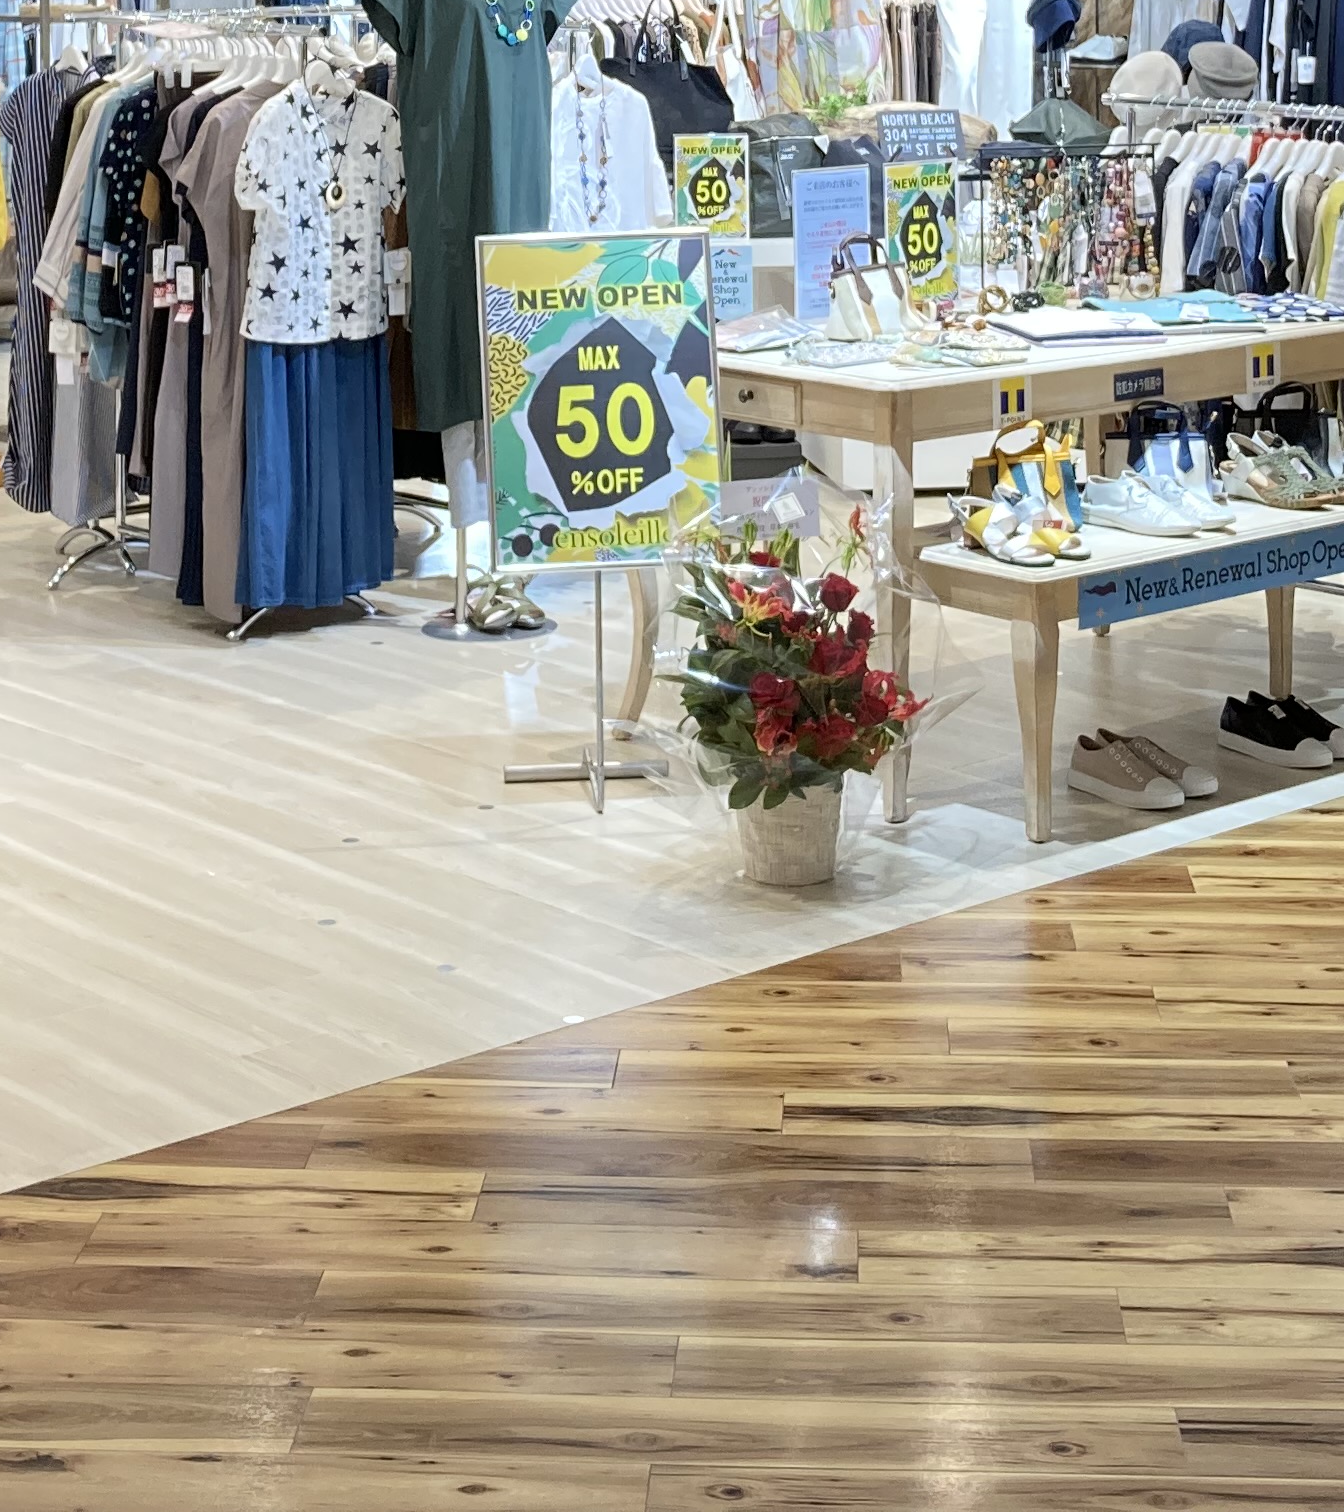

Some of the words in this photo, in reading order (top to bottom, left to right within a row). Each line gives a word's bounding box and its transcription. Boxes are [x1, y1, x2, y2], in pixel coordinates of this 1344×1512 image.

[881, 112, 917, 127] NORTH
[920, 112, 955, 126] BEACH
[883, 128, 908, 142] 304
[682, 146, 707, 155] NEW
[710, 146, 742, 155] OPEN
[702, 166, 718, 178] MAX
[892, 178, 918, 190] NEW
[920, 174, 951, 187] OPEN
[696, 180, 727, 204] 50
[912, 205, 930, 220] MAX
[907, 222, 939, 256] 50
[714, 259, 737, 269] New
[712, 273, 748, 284] enewal
[517, 287, 587, 311] NEW
[597, 283, 683, 308] OPEN
[713, 284, 739, 296] Shop
[713, 296, 741, 308] Open
[578, 345, 619, 371] MAX
[555, 382, 655, 459] 50
[571, 468, 644, 495] %OFF
[1181, 551, 1263, 595] Renewal
[1266, 546, 1311, 577] Shop
